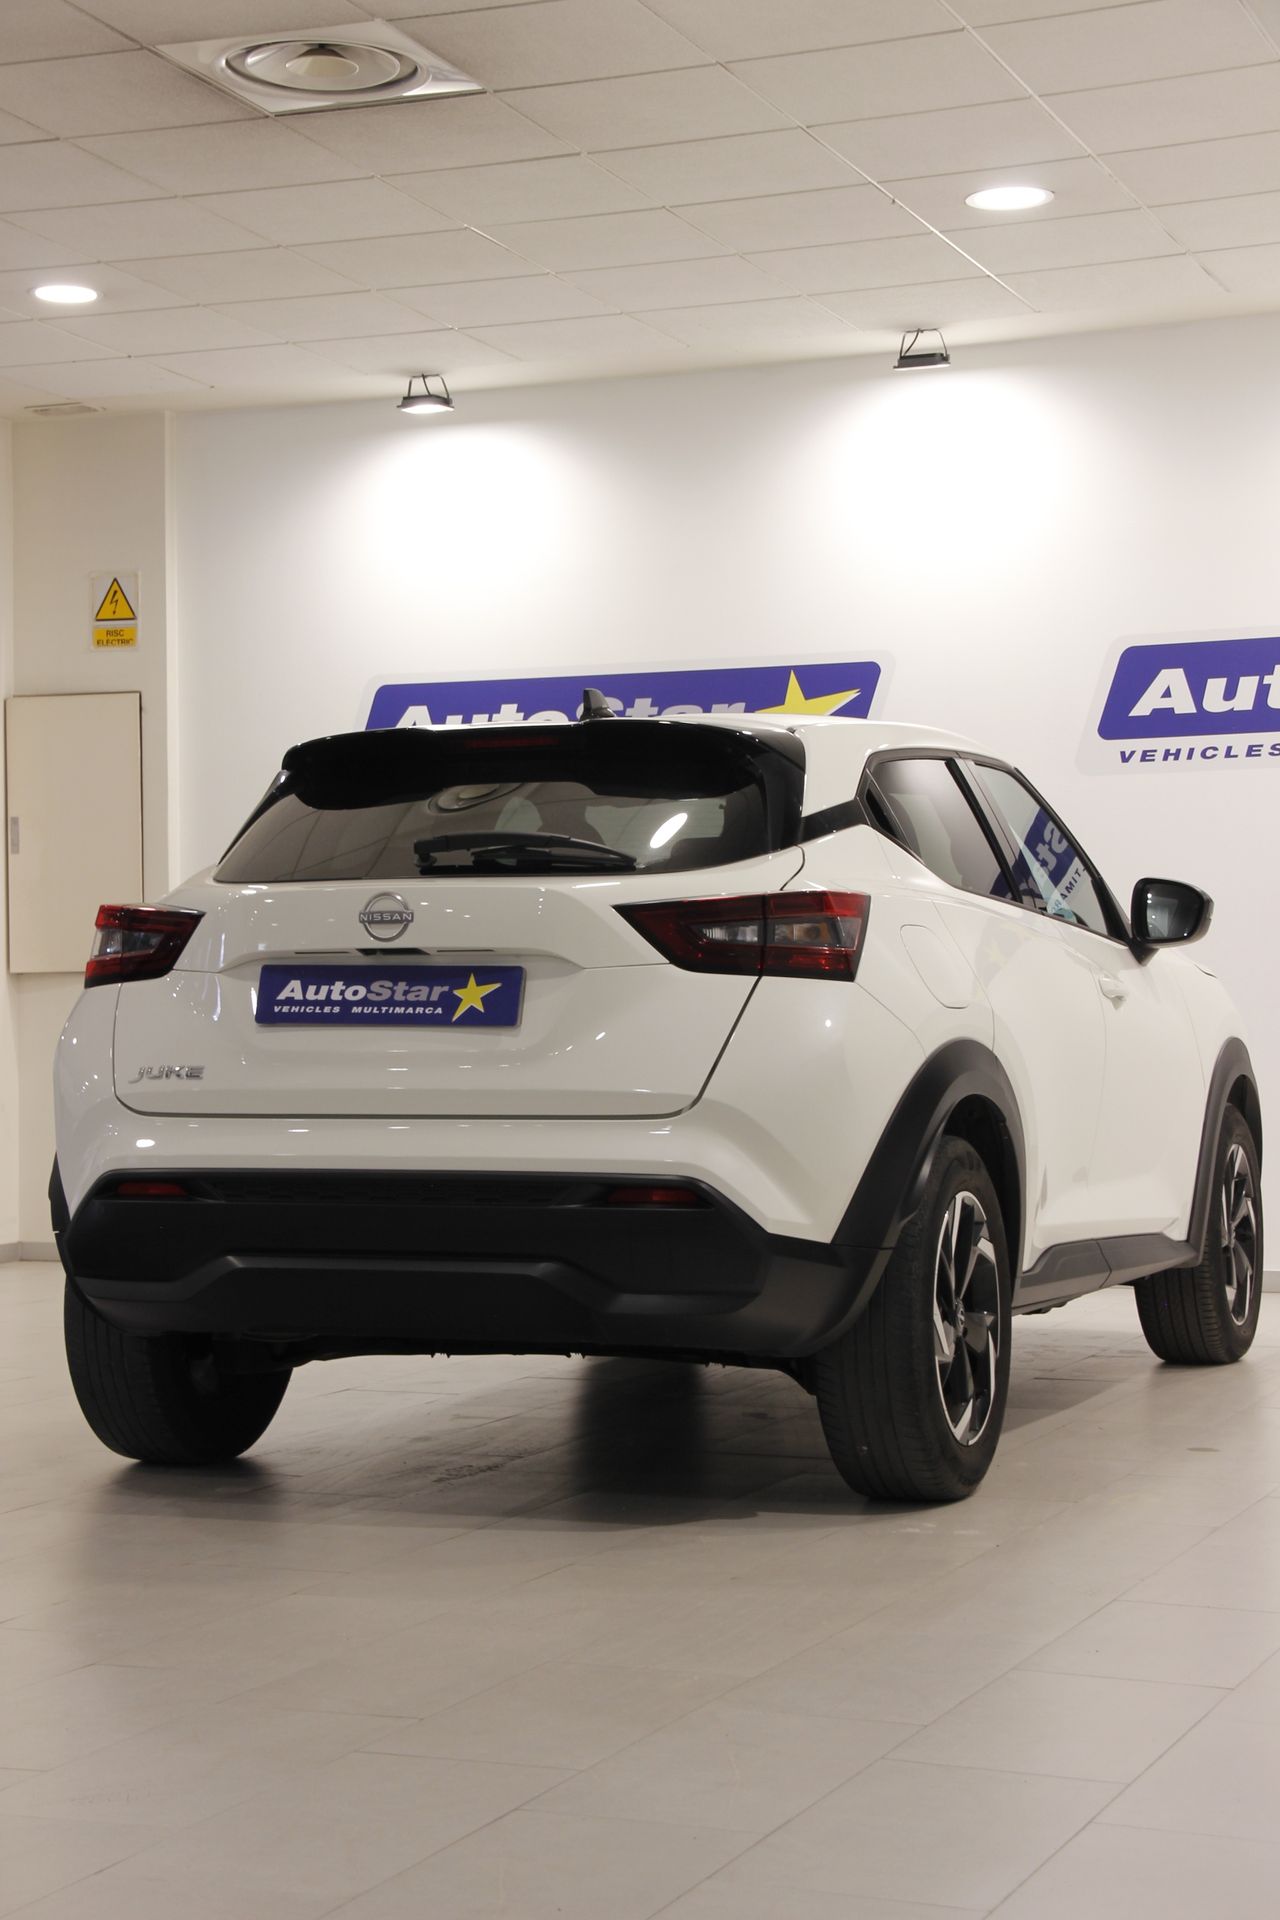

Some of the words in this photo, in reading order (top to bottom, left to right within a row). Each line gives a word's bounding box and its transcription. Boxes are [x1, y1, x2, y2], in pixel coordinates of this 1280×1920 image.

[105, 629, 125, 638] RISC
[360, 912, 412, 921] NISSAN
[276, 979, 449, 1001] AutoStar
[273, 1005, 341, 1013] VEHICLES
[351, 1006, 443, 1014] MULTIMARCA
[128, 1064, 205, 1084] JUKE
